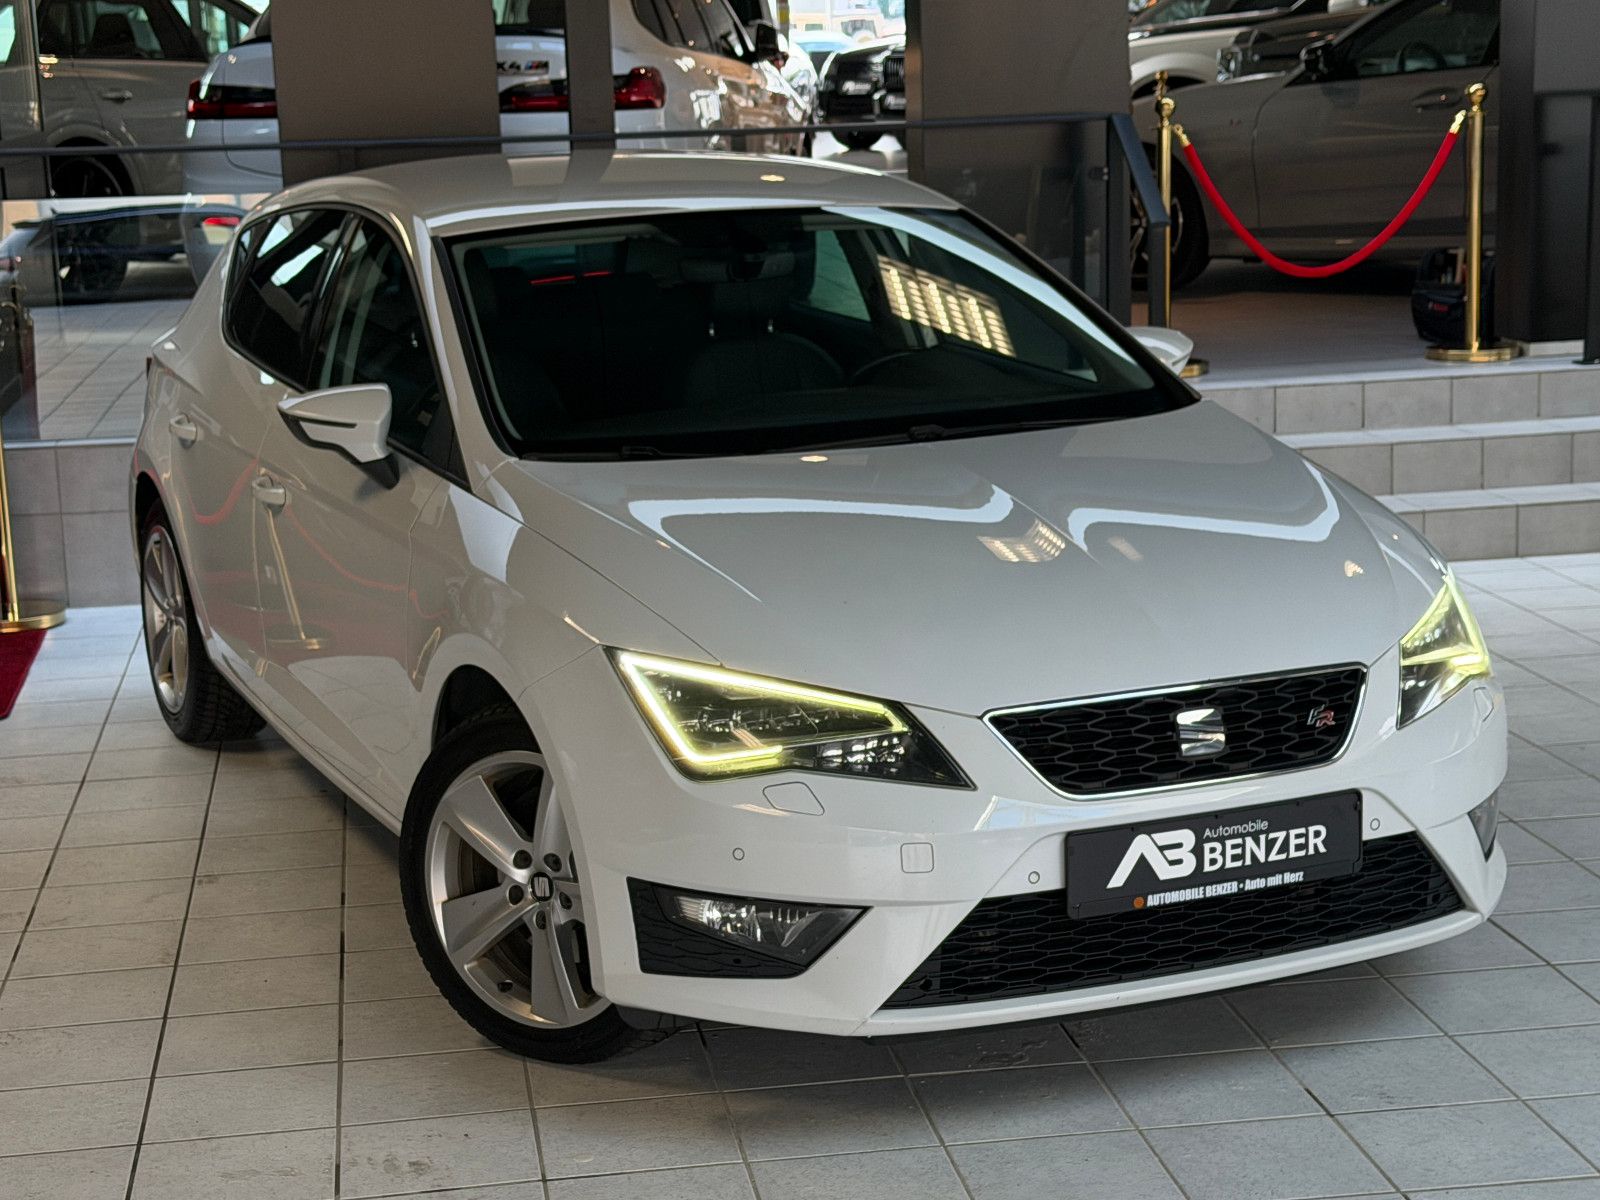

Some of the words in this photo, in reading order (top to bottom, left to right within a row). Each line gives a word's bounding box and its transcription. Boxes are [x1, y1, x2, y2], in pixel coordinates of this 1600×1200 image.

[1306, 703, 1337, 728] FR
[1203, 819, 1269, 840] Automobile
[1202, 824, 1328, 873] BENZER
[1146, 886, 1205, 907] AUTOMOBILE
[1205, 881, 1239, 898] BENZER
[1244, 877, 1266, 891] Auto
[1266, 873, 1283, 887] mit
[1283, 871, 1304, 884] Herz
